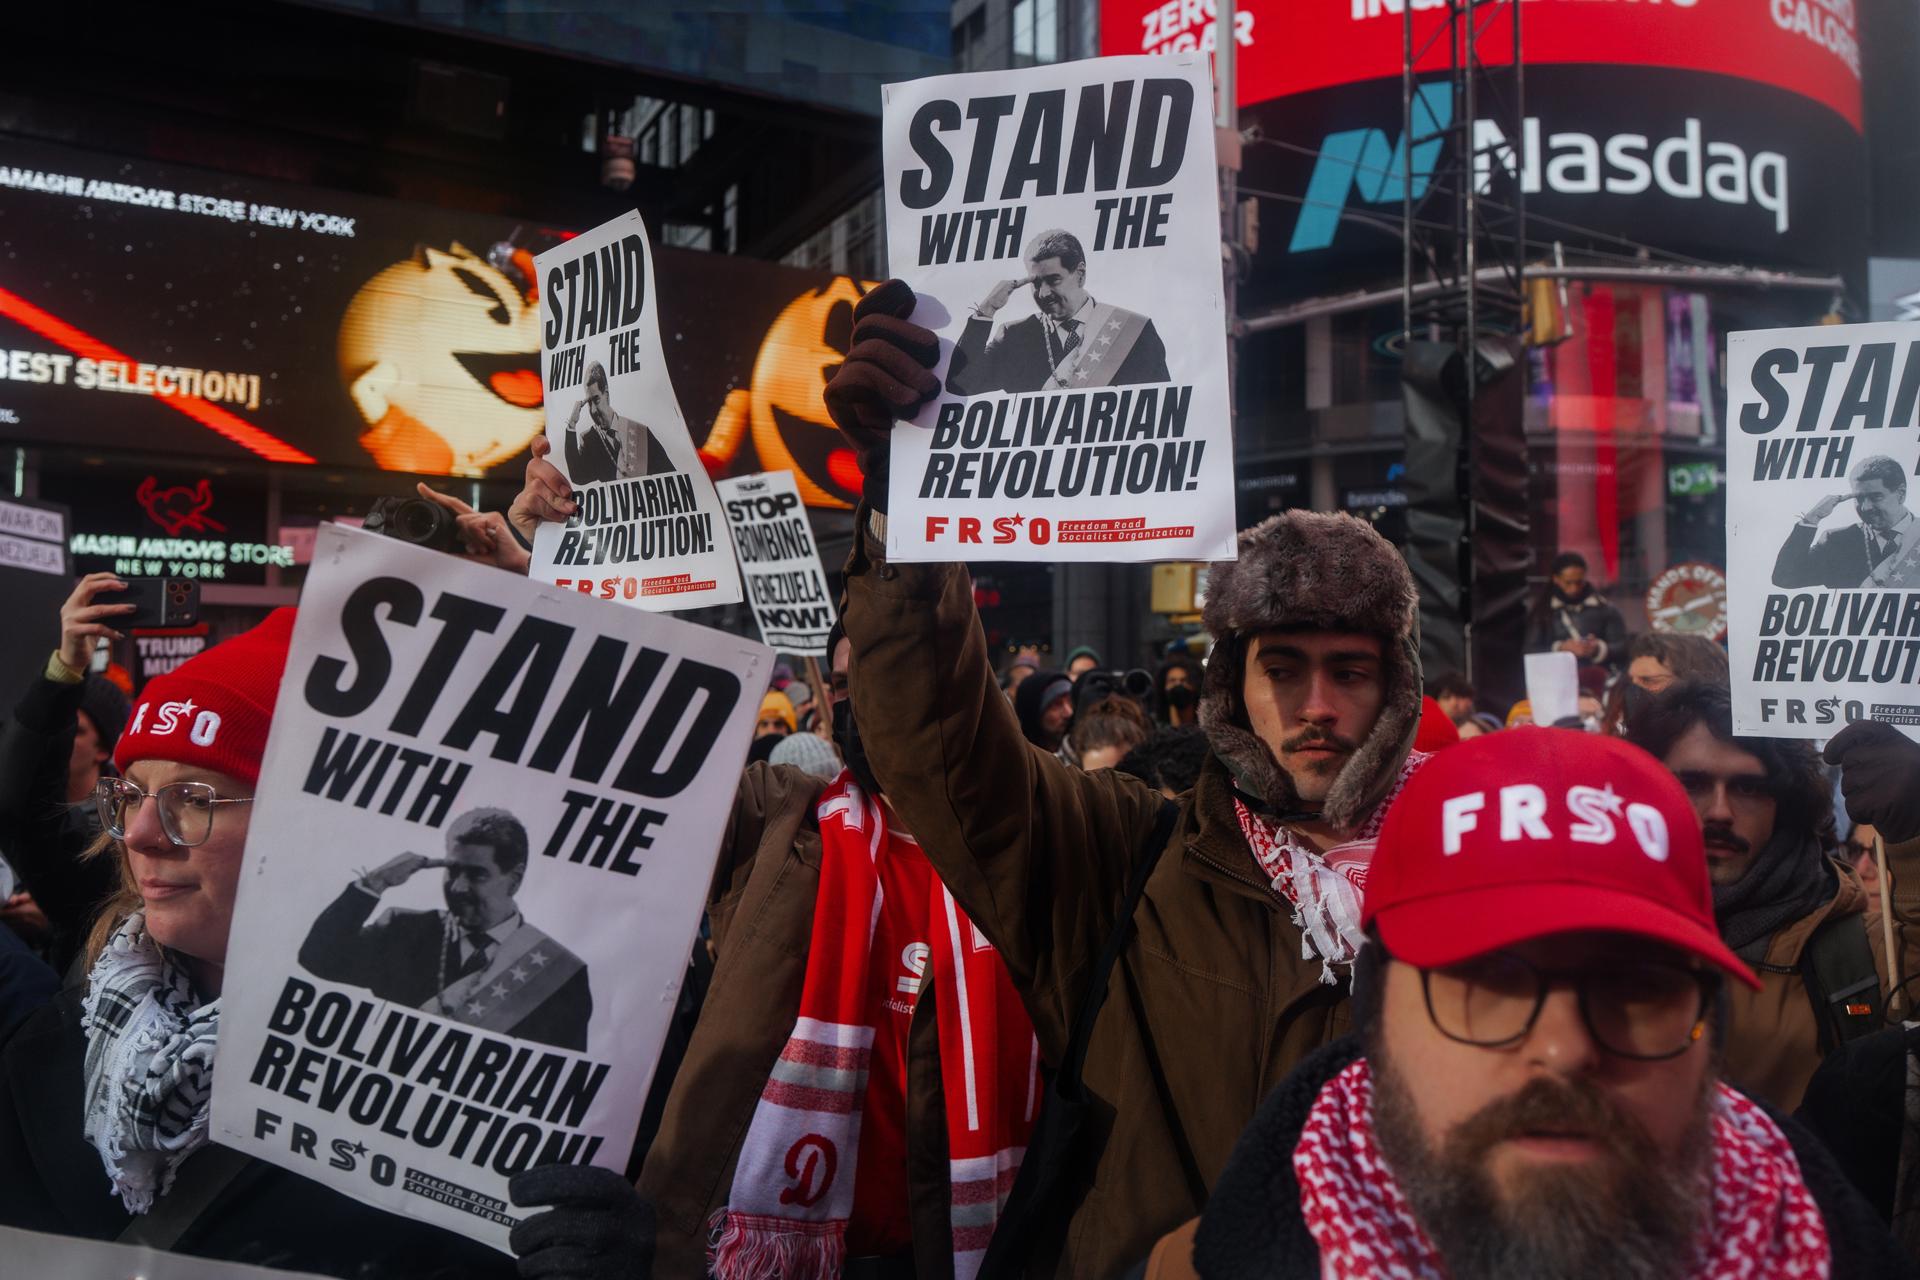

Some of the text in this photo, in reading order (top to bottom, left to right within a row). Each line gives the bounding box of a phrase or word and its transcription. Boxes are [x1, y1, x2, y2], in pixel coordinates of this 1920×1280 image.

[900, 78, 1194, 209] STAND
[1473, 117, 1789, 233] Nasdaq
[178, 193, 247, 223] STORE
[250, 203, 297, 228] NEW
[299, 210, 356, 237] YORK
[918, 193, 1173, 266] WITH THE
[546, 234, 645, 350] STAND
[549, 328, 641, 392] WITH THE
[74, 357, 260, 411] SELECTION]
[930, 386, 1192, 450] BOLIVARIAN
[918, 440, 1206, 499] REVOLUTION!
[1753, 436, 1855, 481] WITH
[565, 474, 697, 528] BOLIVARIAN
[727, 492, 798, 523] STOP
[553, 513, 714, 566] REVOLUTION!
[735, 518, 813, 563] BOMBING
[1062, 521, 1108, 531] Freedom
[1114, 520, 1142, 530] Road
[1062, 527, 1192, 542] Socialist Organization
[115, 559, 225, 578] NEW YORK
[229, 543, 295, 568] STORE
[674, 575, 689, 584] Road
[676, 581, 715, 593] Organization
[748, 569, 825, 606] VENEZUELA
[757, 607, 832, 630] NOW!
[137, 636, 206, 657] TRUMP
[304, 576, 741, 799] STAND
[1874, 705, 1915, 715] Freedom
[302, 727, 669, 877] WITH THE
[267, 976, 611, 1128] BOLIVARIAN
[407, 1181, 517, 1228] Socialist Organi
[409, 1170, 463, 1197] Freedom
[469, 1191, 503, 1210] Road
